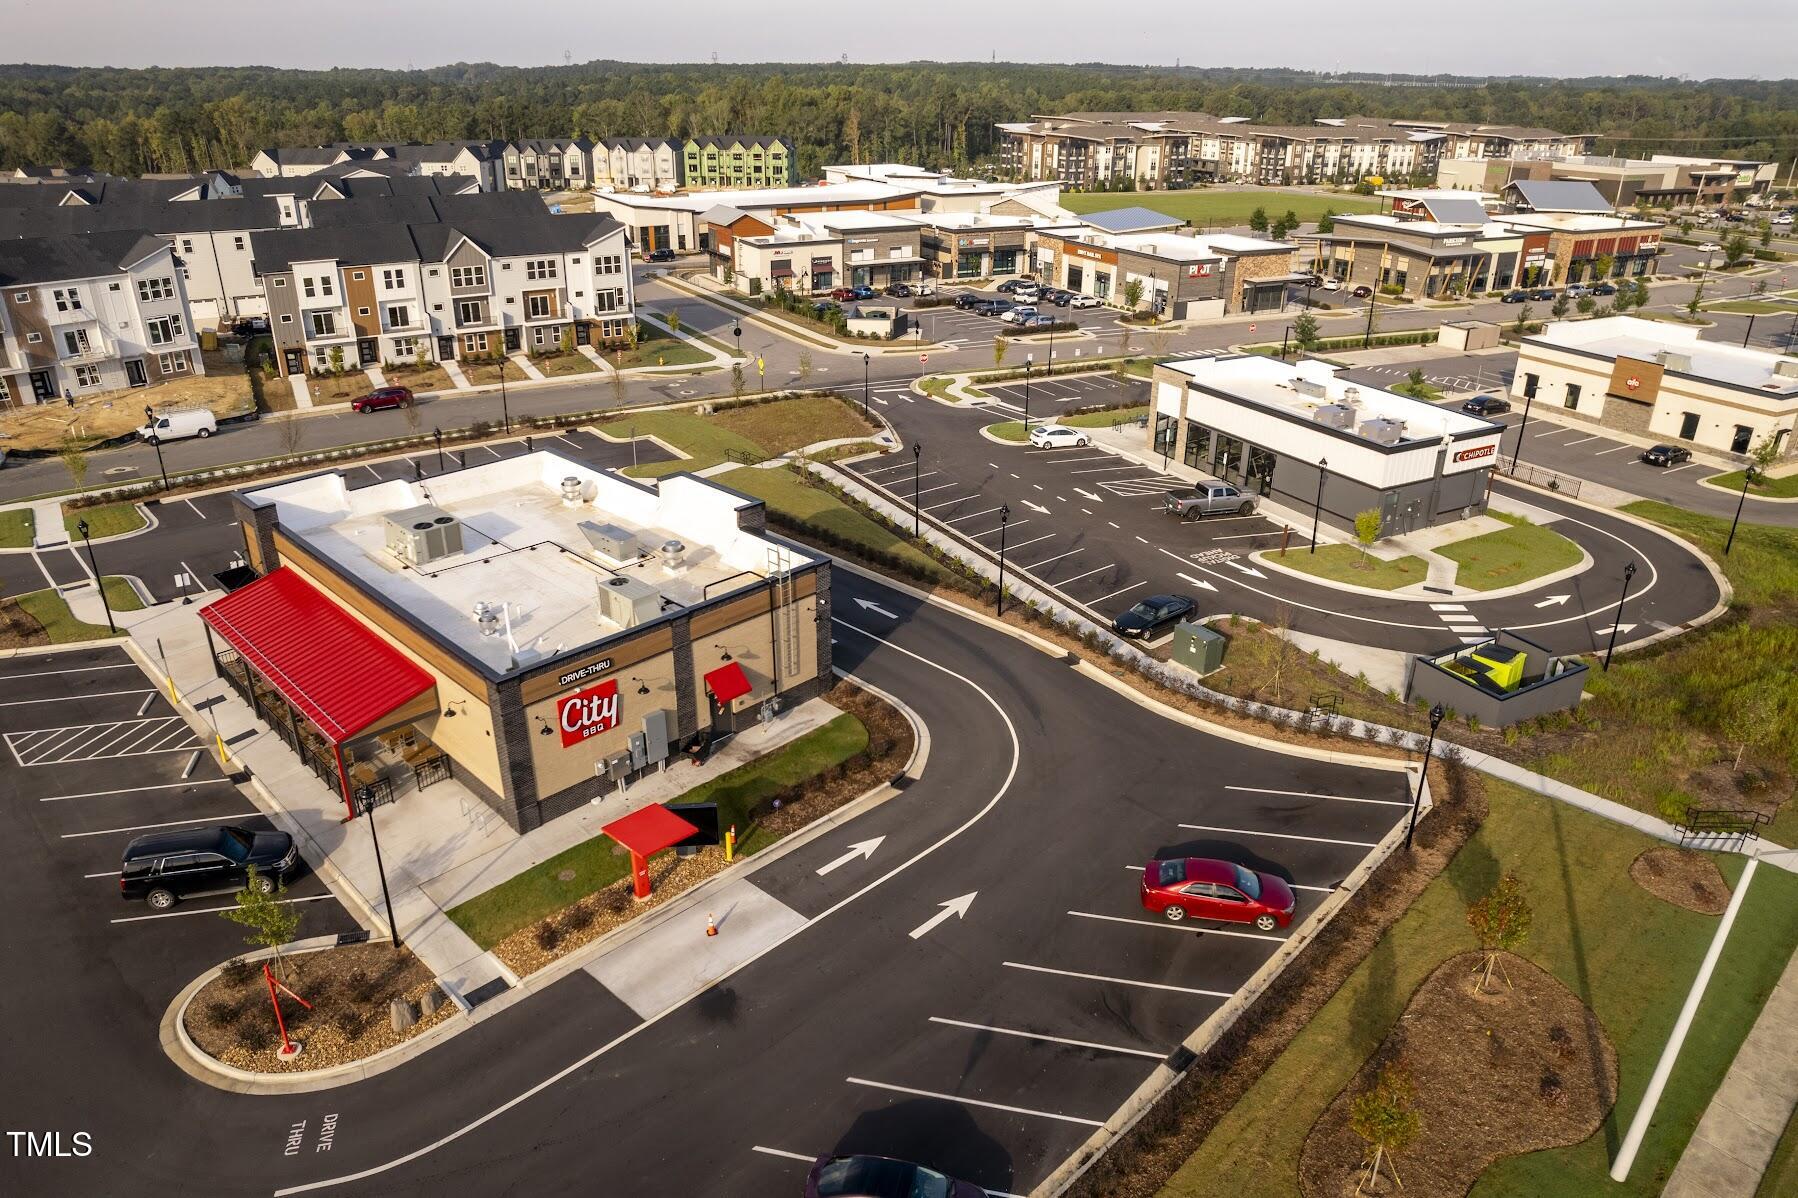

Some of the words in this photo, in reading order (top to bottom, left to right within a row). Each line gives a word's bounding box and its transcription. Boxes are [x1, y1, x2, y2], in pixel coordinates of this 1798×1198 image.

[1463, 446, 1496, 460] CHIPOTLE
[561, 660, 611, 685] DRIVE-THRU
[561, 693, 618, 733] City
[582, 722, 605, 738] BBQ
[284, 1119, 307, 1156] THRU
[316, 1113, 339, 1153] DRIVE
